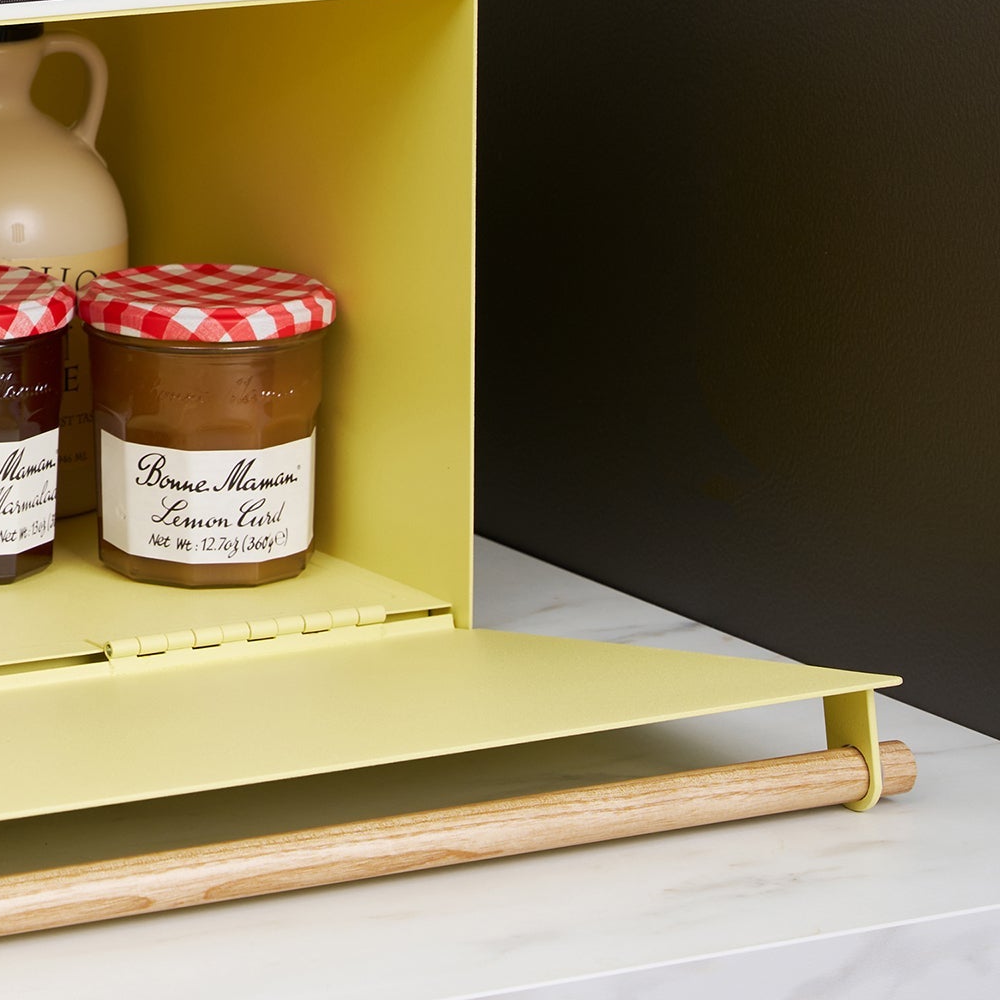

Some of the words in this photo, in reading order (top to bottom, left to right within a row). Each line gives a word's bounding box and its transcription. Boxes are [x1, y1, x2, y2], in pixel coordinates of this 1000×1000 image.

[135, 452, 210, 493] Bonne
[213, 457, 299, 493] Maman
[151, 495, 233, 529] Lemon
[237, 498, 285, 528] Curd
[148, 533, 171, 548] Net
[201, 537, 239, 558] 12.7oz
